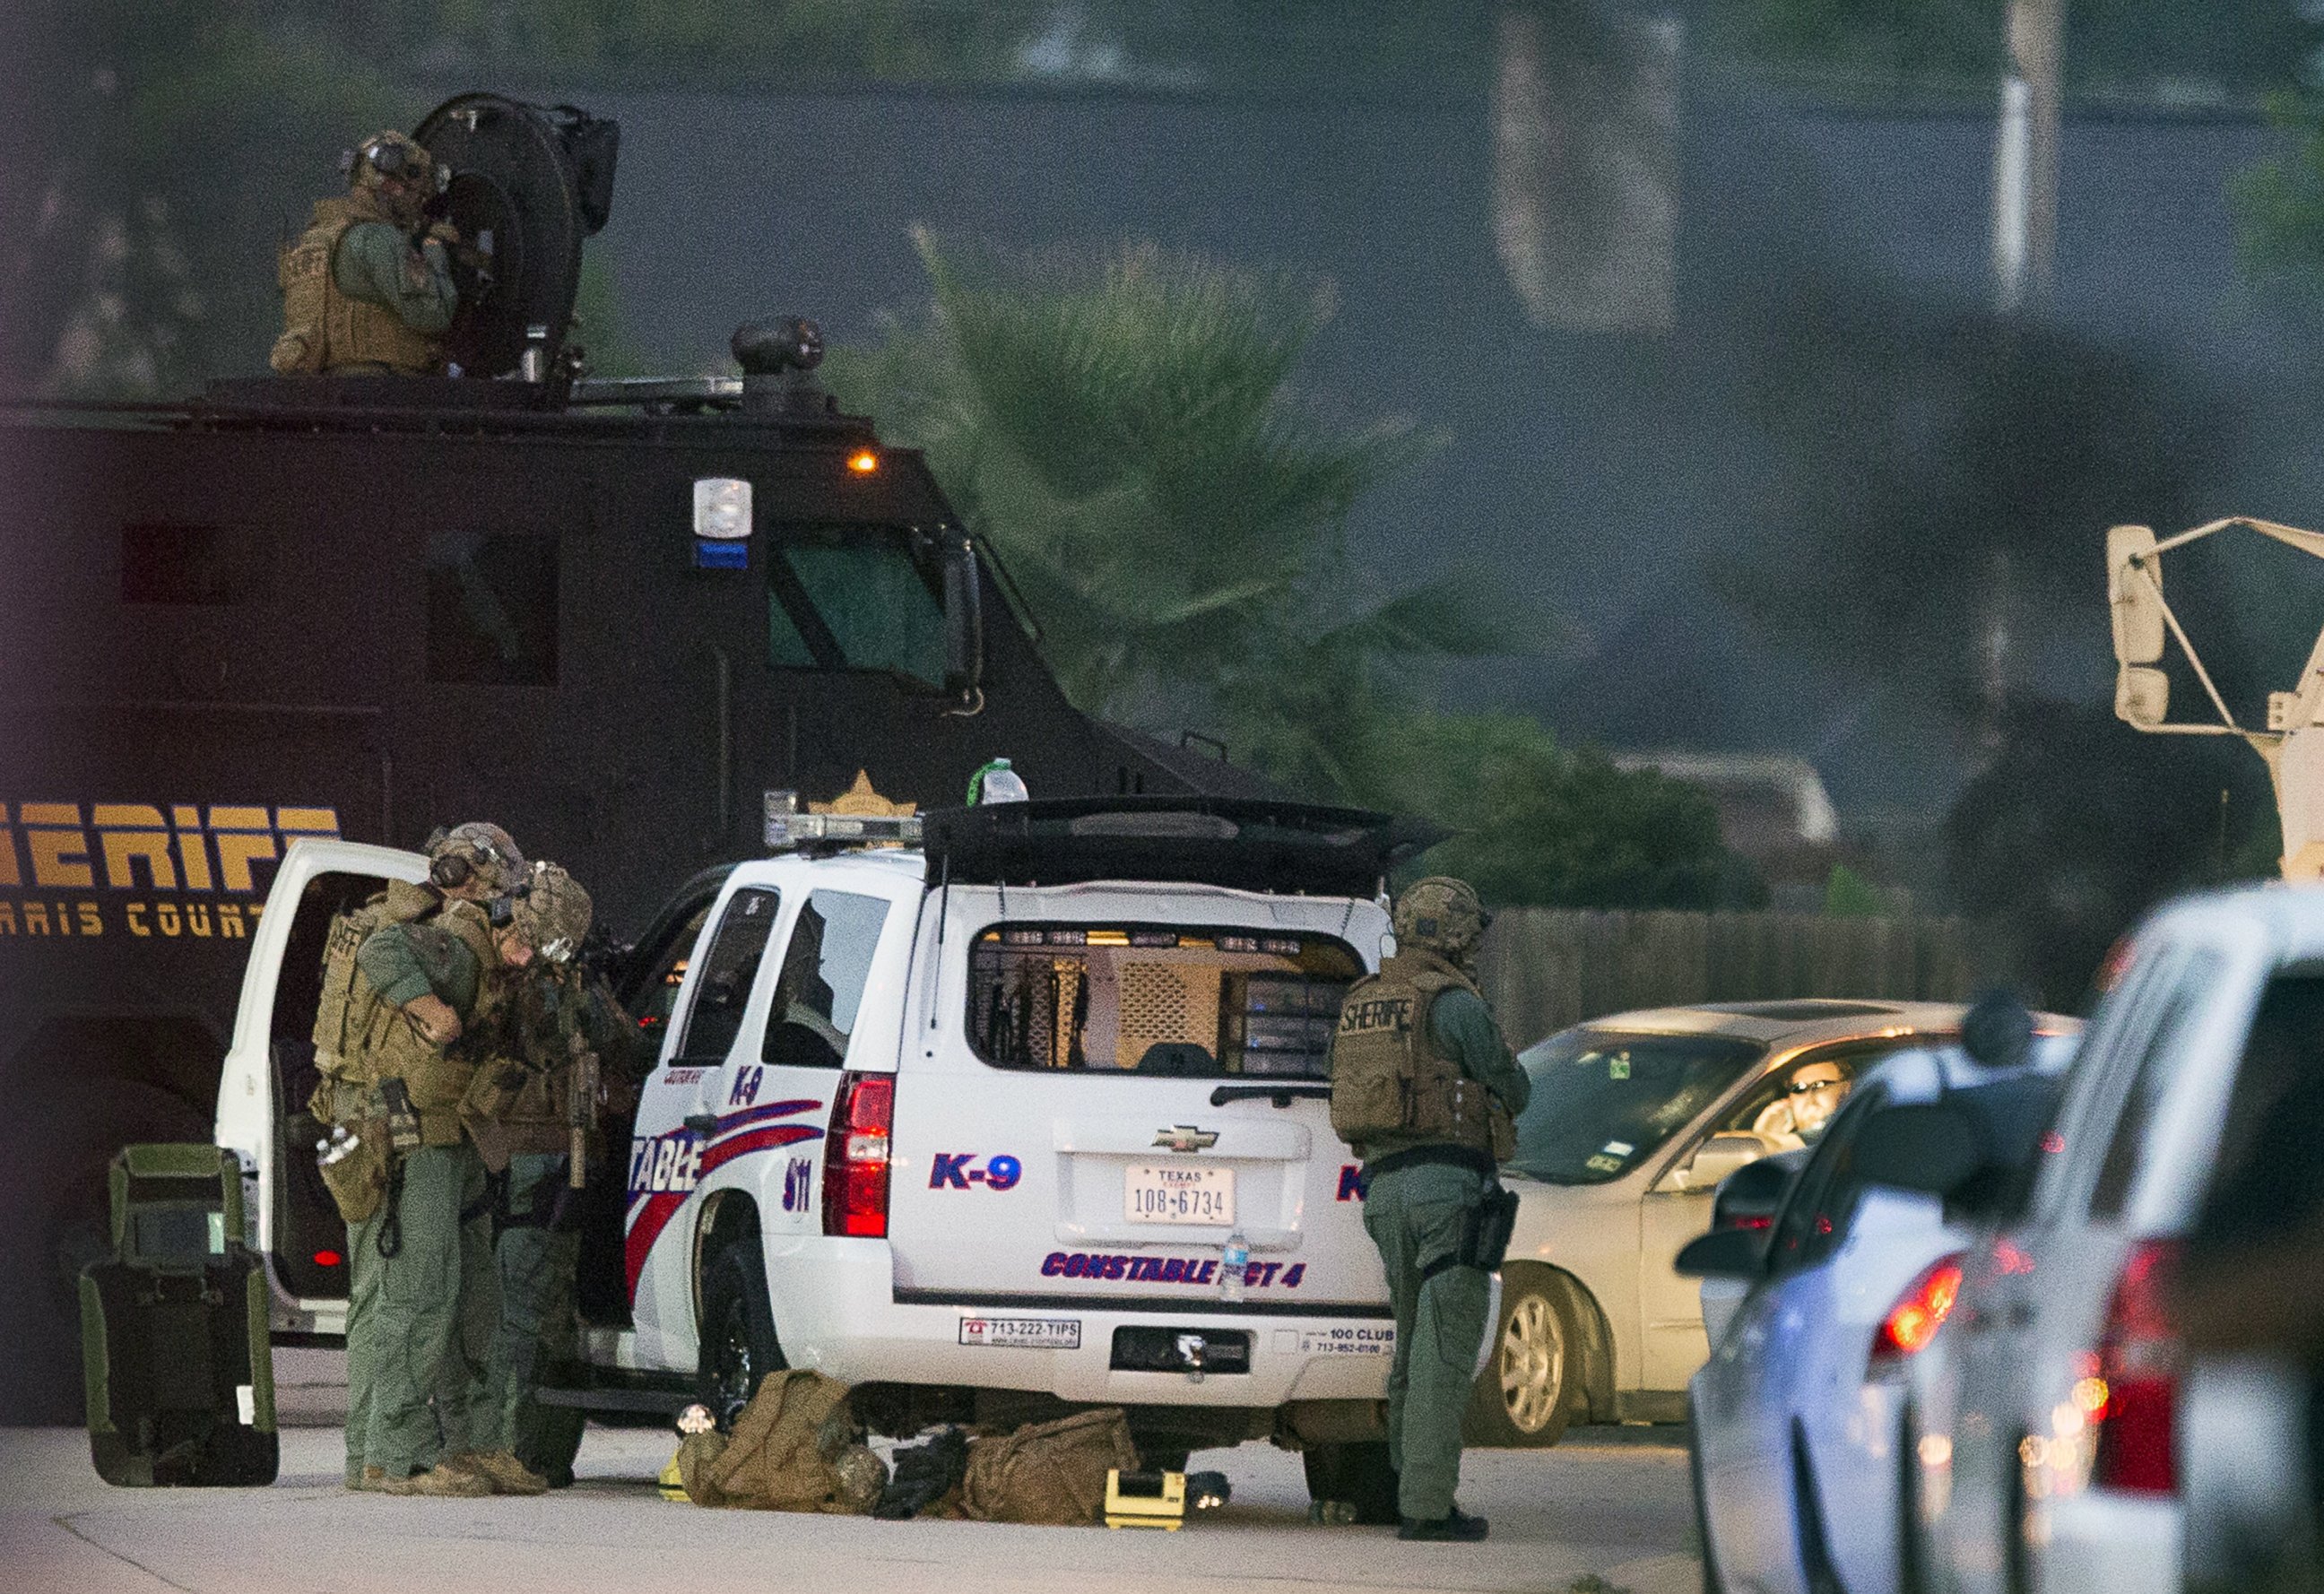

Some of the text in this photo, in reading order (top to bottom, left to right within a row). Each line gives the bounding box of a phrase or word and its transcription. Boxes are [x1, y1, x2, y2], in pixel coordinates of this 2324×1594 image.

[1342, 999, 1413, 1031] SHERIFF
[729, 1065, 763, 1106] K-9
[928, 1153, 1022, 1191] K-9
[1159, 1170, 1201, 1182] TEXAS
[1040, 1252, 1307, 1288] CONSTABLE CT 4
[991, 1322, 1077, 1336] 713-222-TIPS
[1330, 1329, 1395, 1341] 100 CLUB
